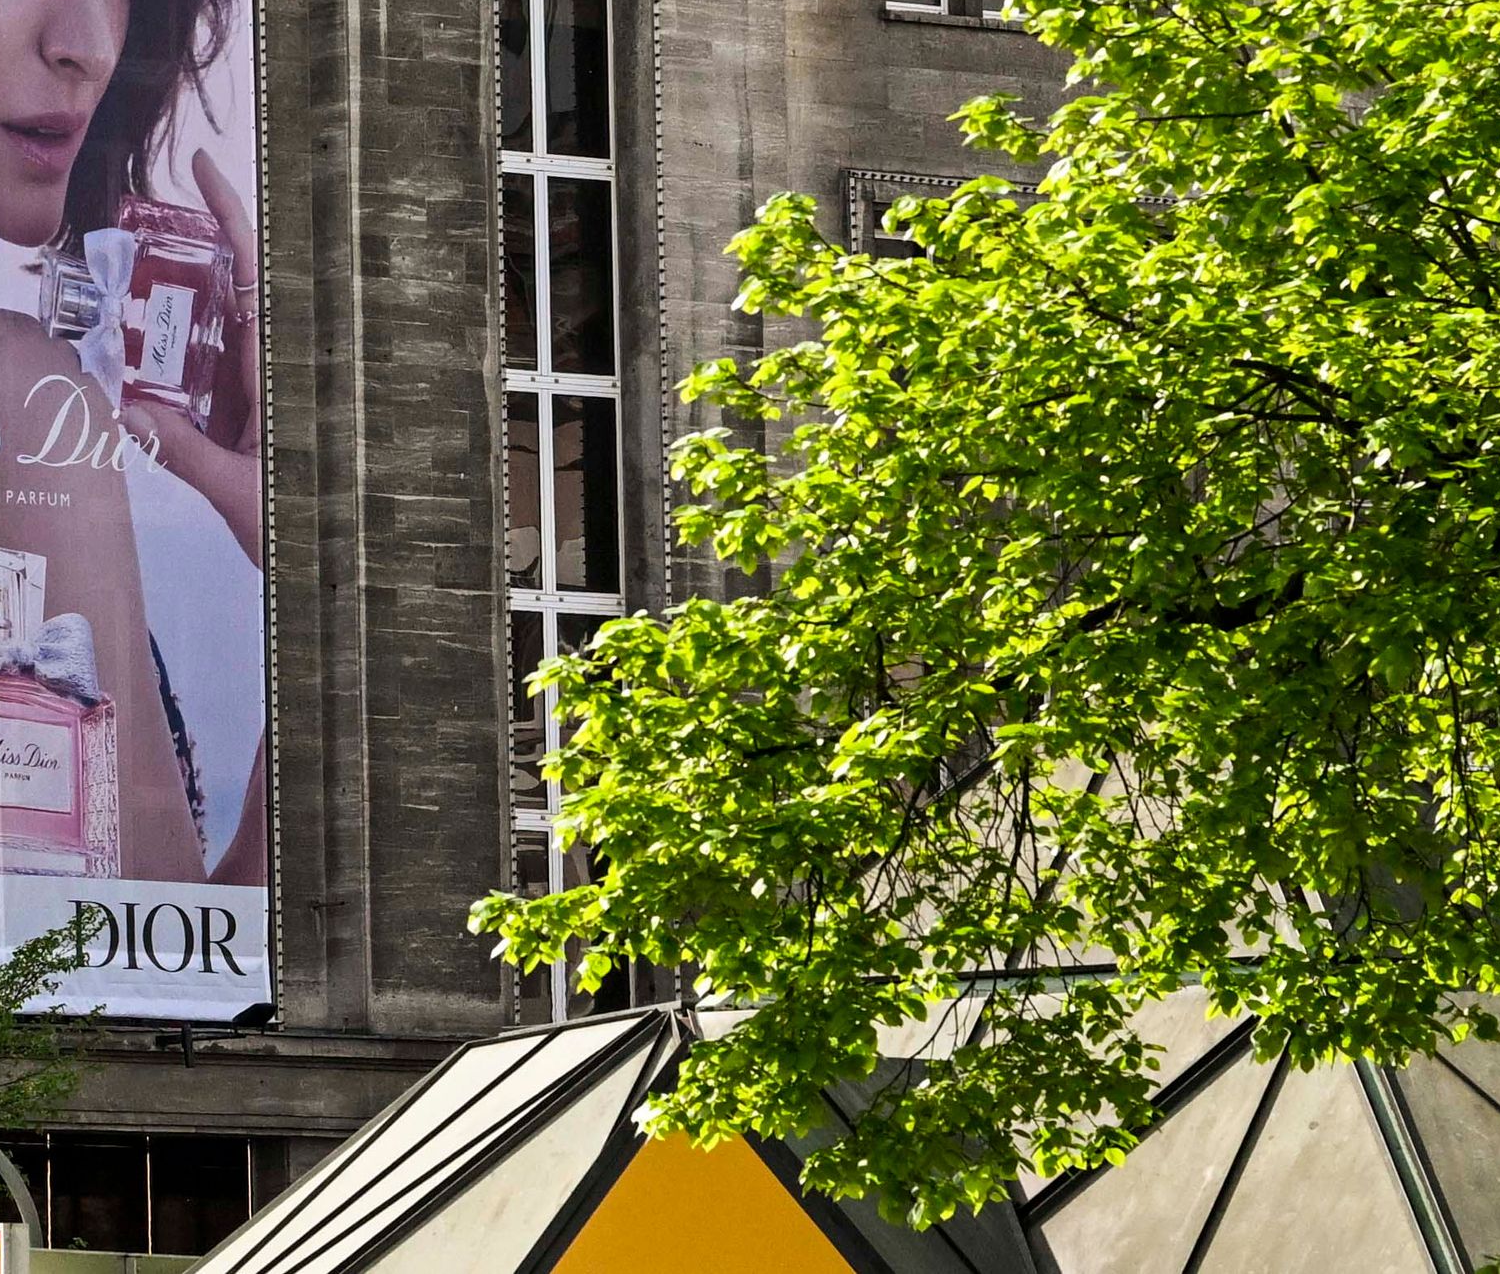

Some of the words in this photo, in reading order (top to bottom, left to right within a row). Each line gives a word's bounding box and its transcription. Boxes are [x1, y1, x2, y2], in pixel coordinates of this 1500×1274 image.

[16, 374, 168, 473] Dior
[5, 490, 71, 507] PARFUM
[22, 743, 60, 771] Dior
[67, 899, 248, 977] DIOR
